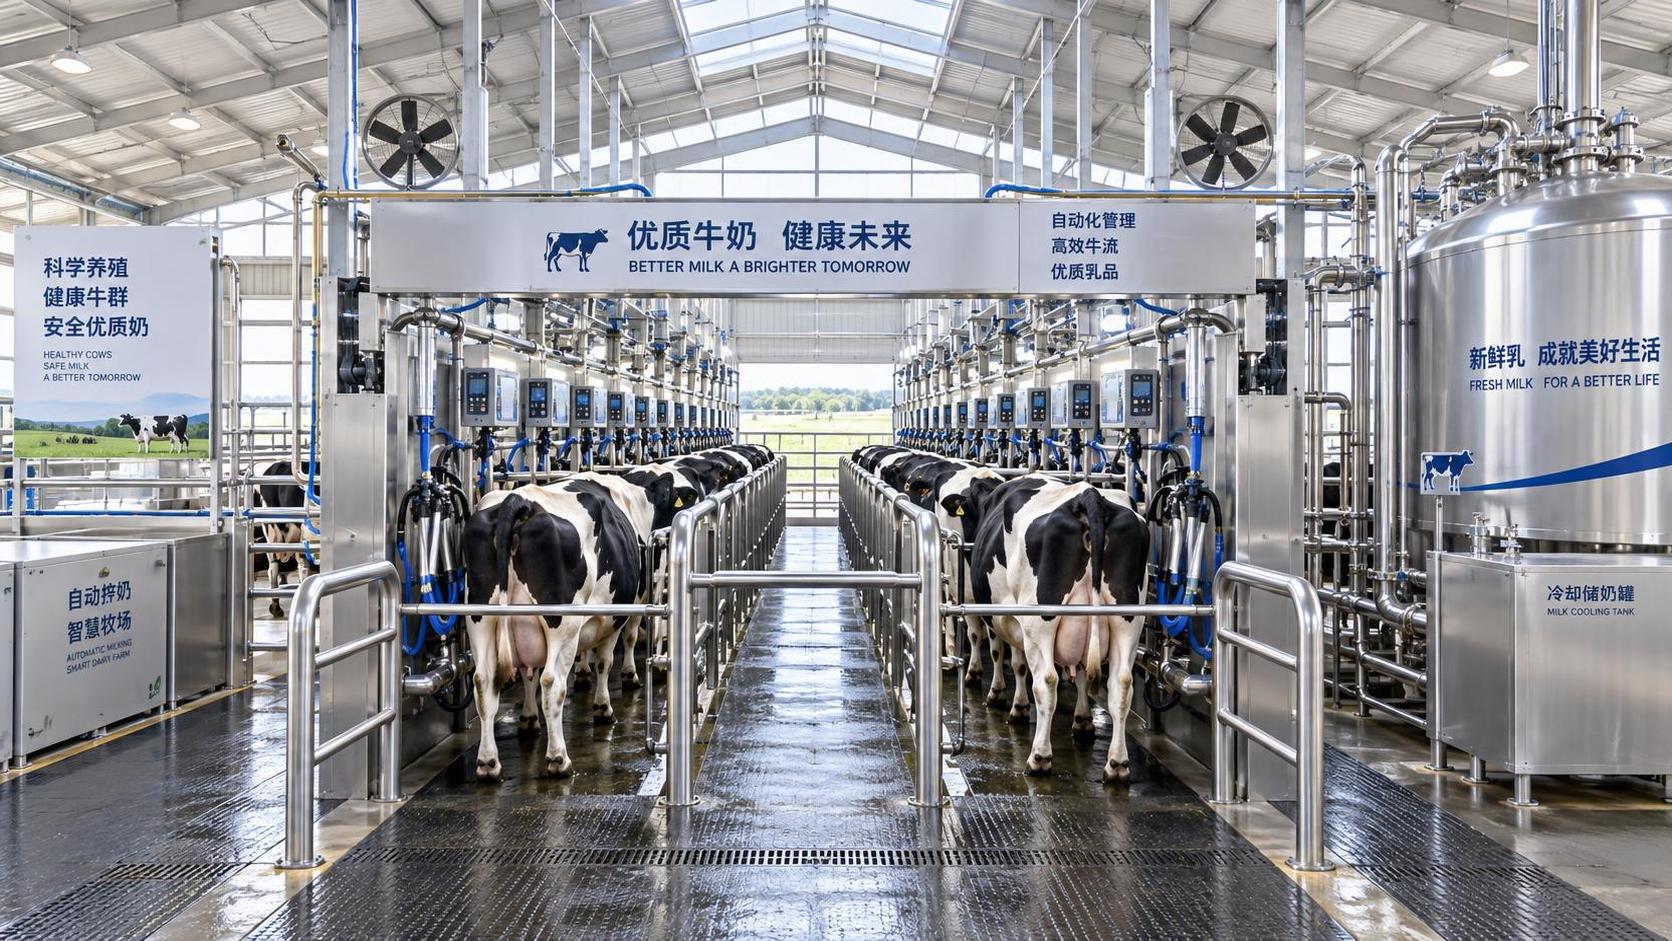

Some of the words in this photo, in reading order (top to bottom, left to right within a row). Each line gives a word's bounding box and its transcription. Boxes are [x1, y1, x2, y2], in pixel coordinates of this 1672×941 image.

[1053, 212, 1136, 229] 自动化管理
[628, 220, 756, 250] 优质牛奶
[783, 220, 911, 251] 健康未来
[1052, 237, 1118, 254] 高效牛流
[44, 257, 128, 278] 科学养殖
[630, 261, 684, 272] BETTER
[690, 261, 724, 272] MILK
[729, 261, 739, 272] A
[744, 261, 816, 272] BRIGHTER
[821, 261, 910, 273] TOMORROW
[1051, 263, 1118, 280] 优质乳品
[44, 286, 128, 307] 健康牛群
[44, 316, 148, 337] 安全优质奶
[44, 351, 83, 359] HEALTHY
[1469, 344, 1525, 370] 新鲜乳
[1538, 337, 1660, 366] 成就美好生活
[44, 362, 65, 370] SAFE
[53, 373, 85, 381] BETTER
[1470, 379, 1502, 391] FRESH
[1507, 378, 1533, 389] MILK
[1544, 376, 1567, 388] FOR
[1571, 376, 1580, 387] A
[1584, 375, 1631, 387] BETTER
[1635, 374, 1659, 386] LIFE
[1548, 585, 1634, 602] 冷却储奶罐
[1548, 608, 1568, 616] MILK
[1571, 608, 1610, 616] COOLING
[67, 660, 91, 674] SMART
